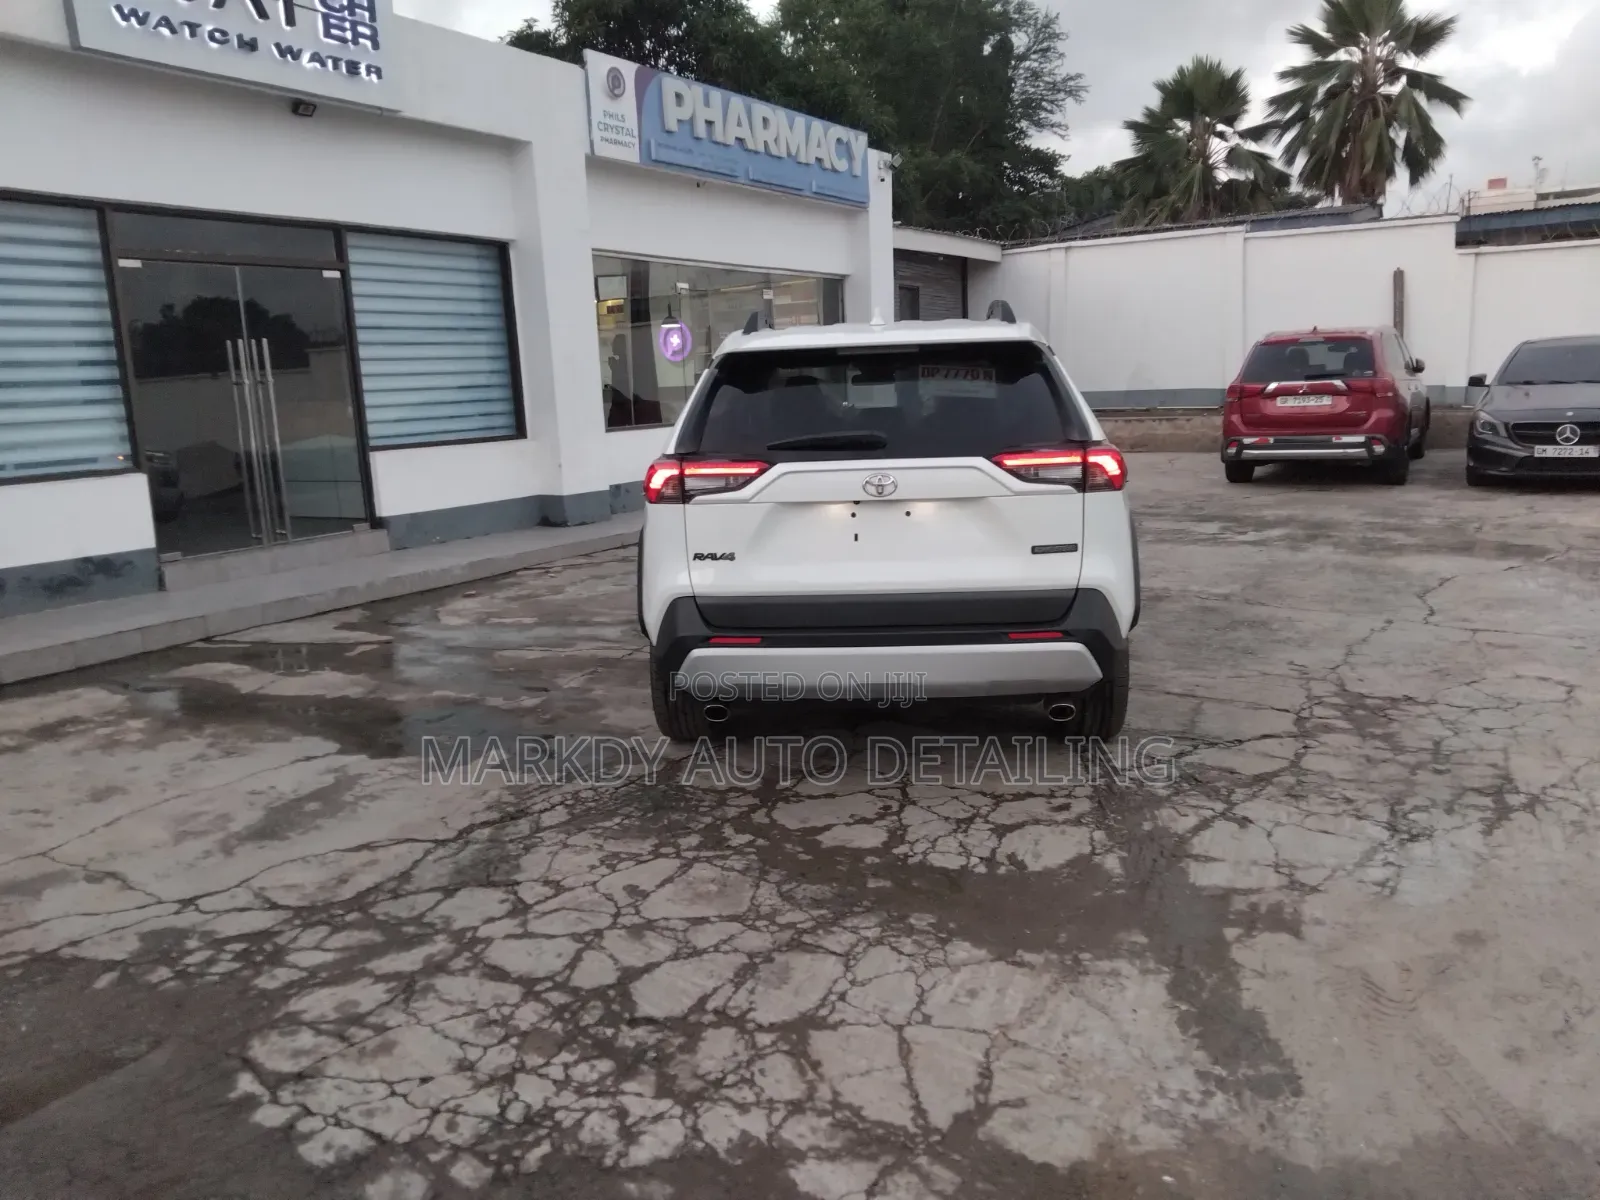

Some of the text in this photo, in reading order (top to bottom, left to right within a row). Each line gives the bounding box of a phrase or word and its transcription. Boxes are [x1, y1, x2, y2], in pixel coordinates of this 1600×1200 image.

[319, 12, 380, 51] ER
[112, 3, 259, 52] WATCH
[272, 42, 384, 82] WATER
[603, 109, 626, 123] PHILS
[597, 121, 637, 139] CRYSTAL
[660, 77, 868, 177] PHARMACY
[600, 135, 636, 149] PHARMACY
[692, 551, 736, 561] RAV4
